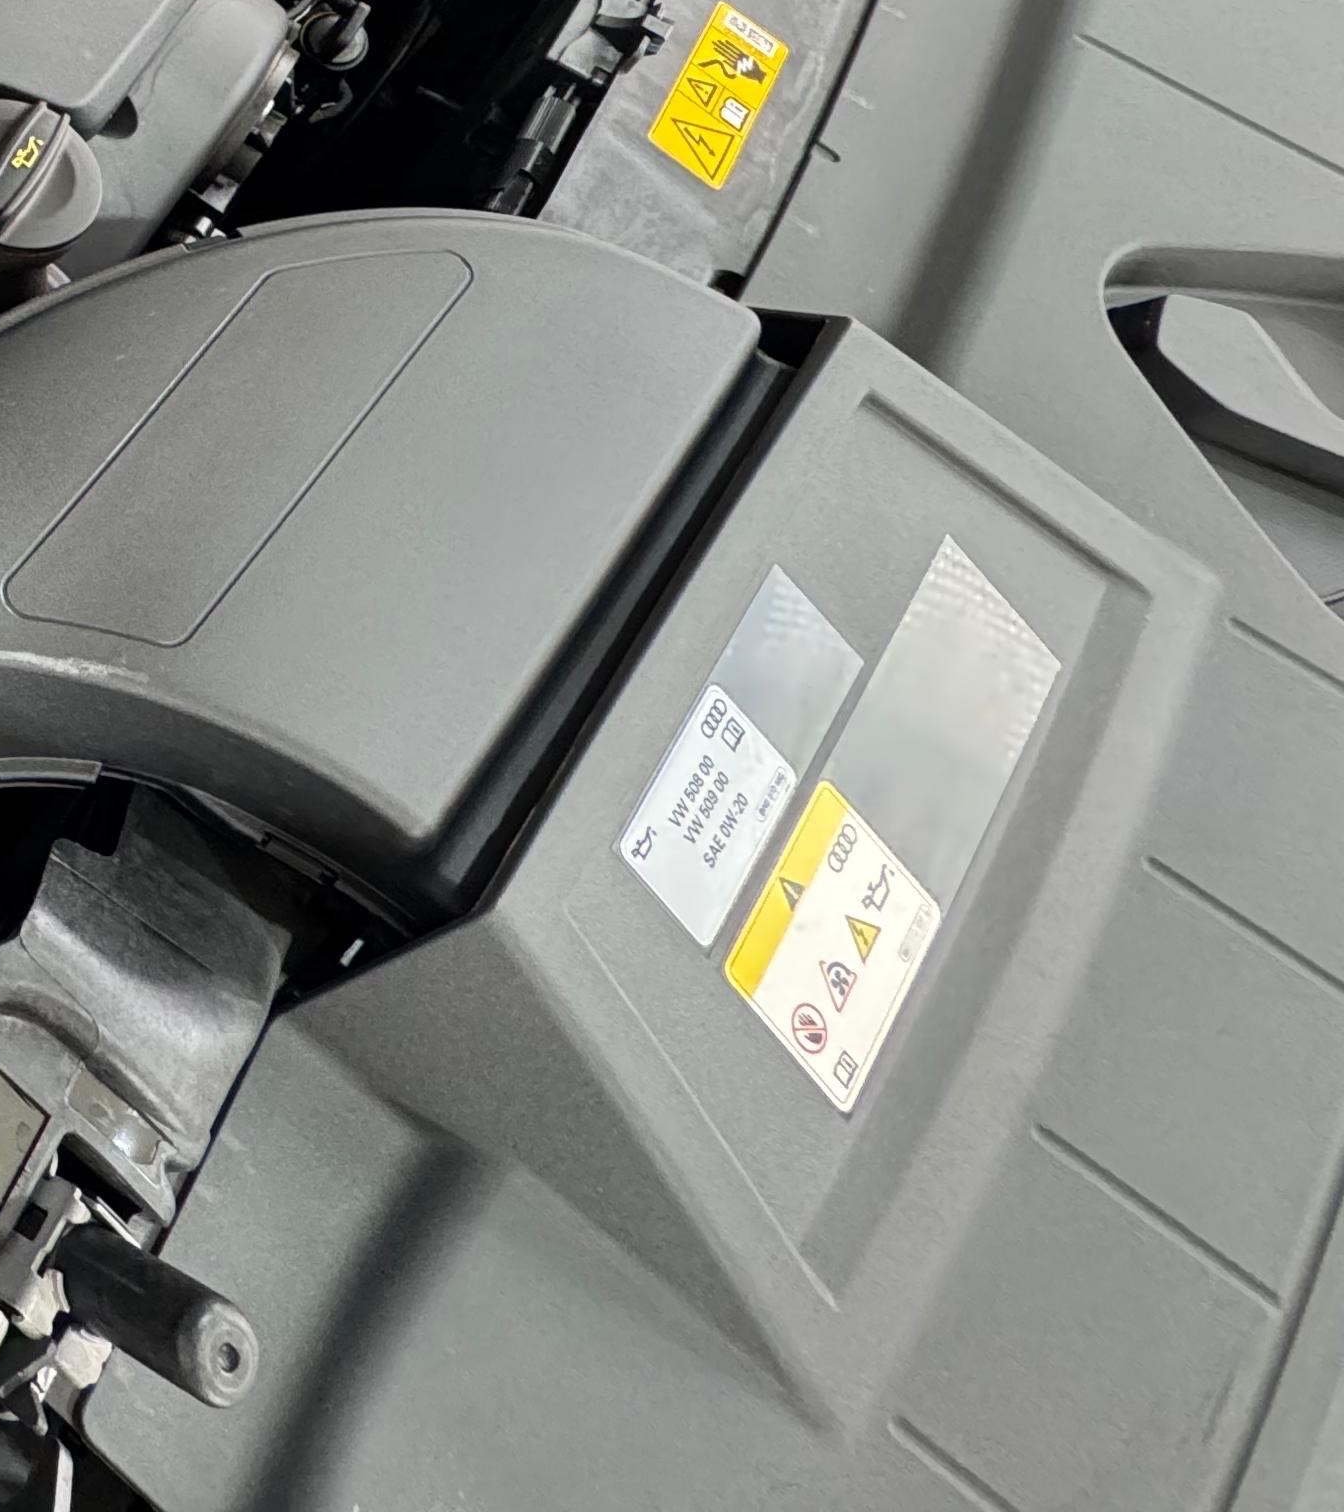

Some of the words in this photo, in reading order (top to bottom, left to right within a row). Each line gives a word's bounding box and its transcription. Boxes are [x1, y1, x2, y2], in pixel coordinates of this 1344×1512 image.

[667, 797, 690, 828] VW
[683, 772, 705, 804] 508
[698, 754, 715, 777] 00
[683, 814, 705, 844] VW
[698, 789, 719, 820] 509
[713, 771, 729, 793] 00
[703, 833, 727, 869] SAE
[719, 792, 749, 839] 0W-20
